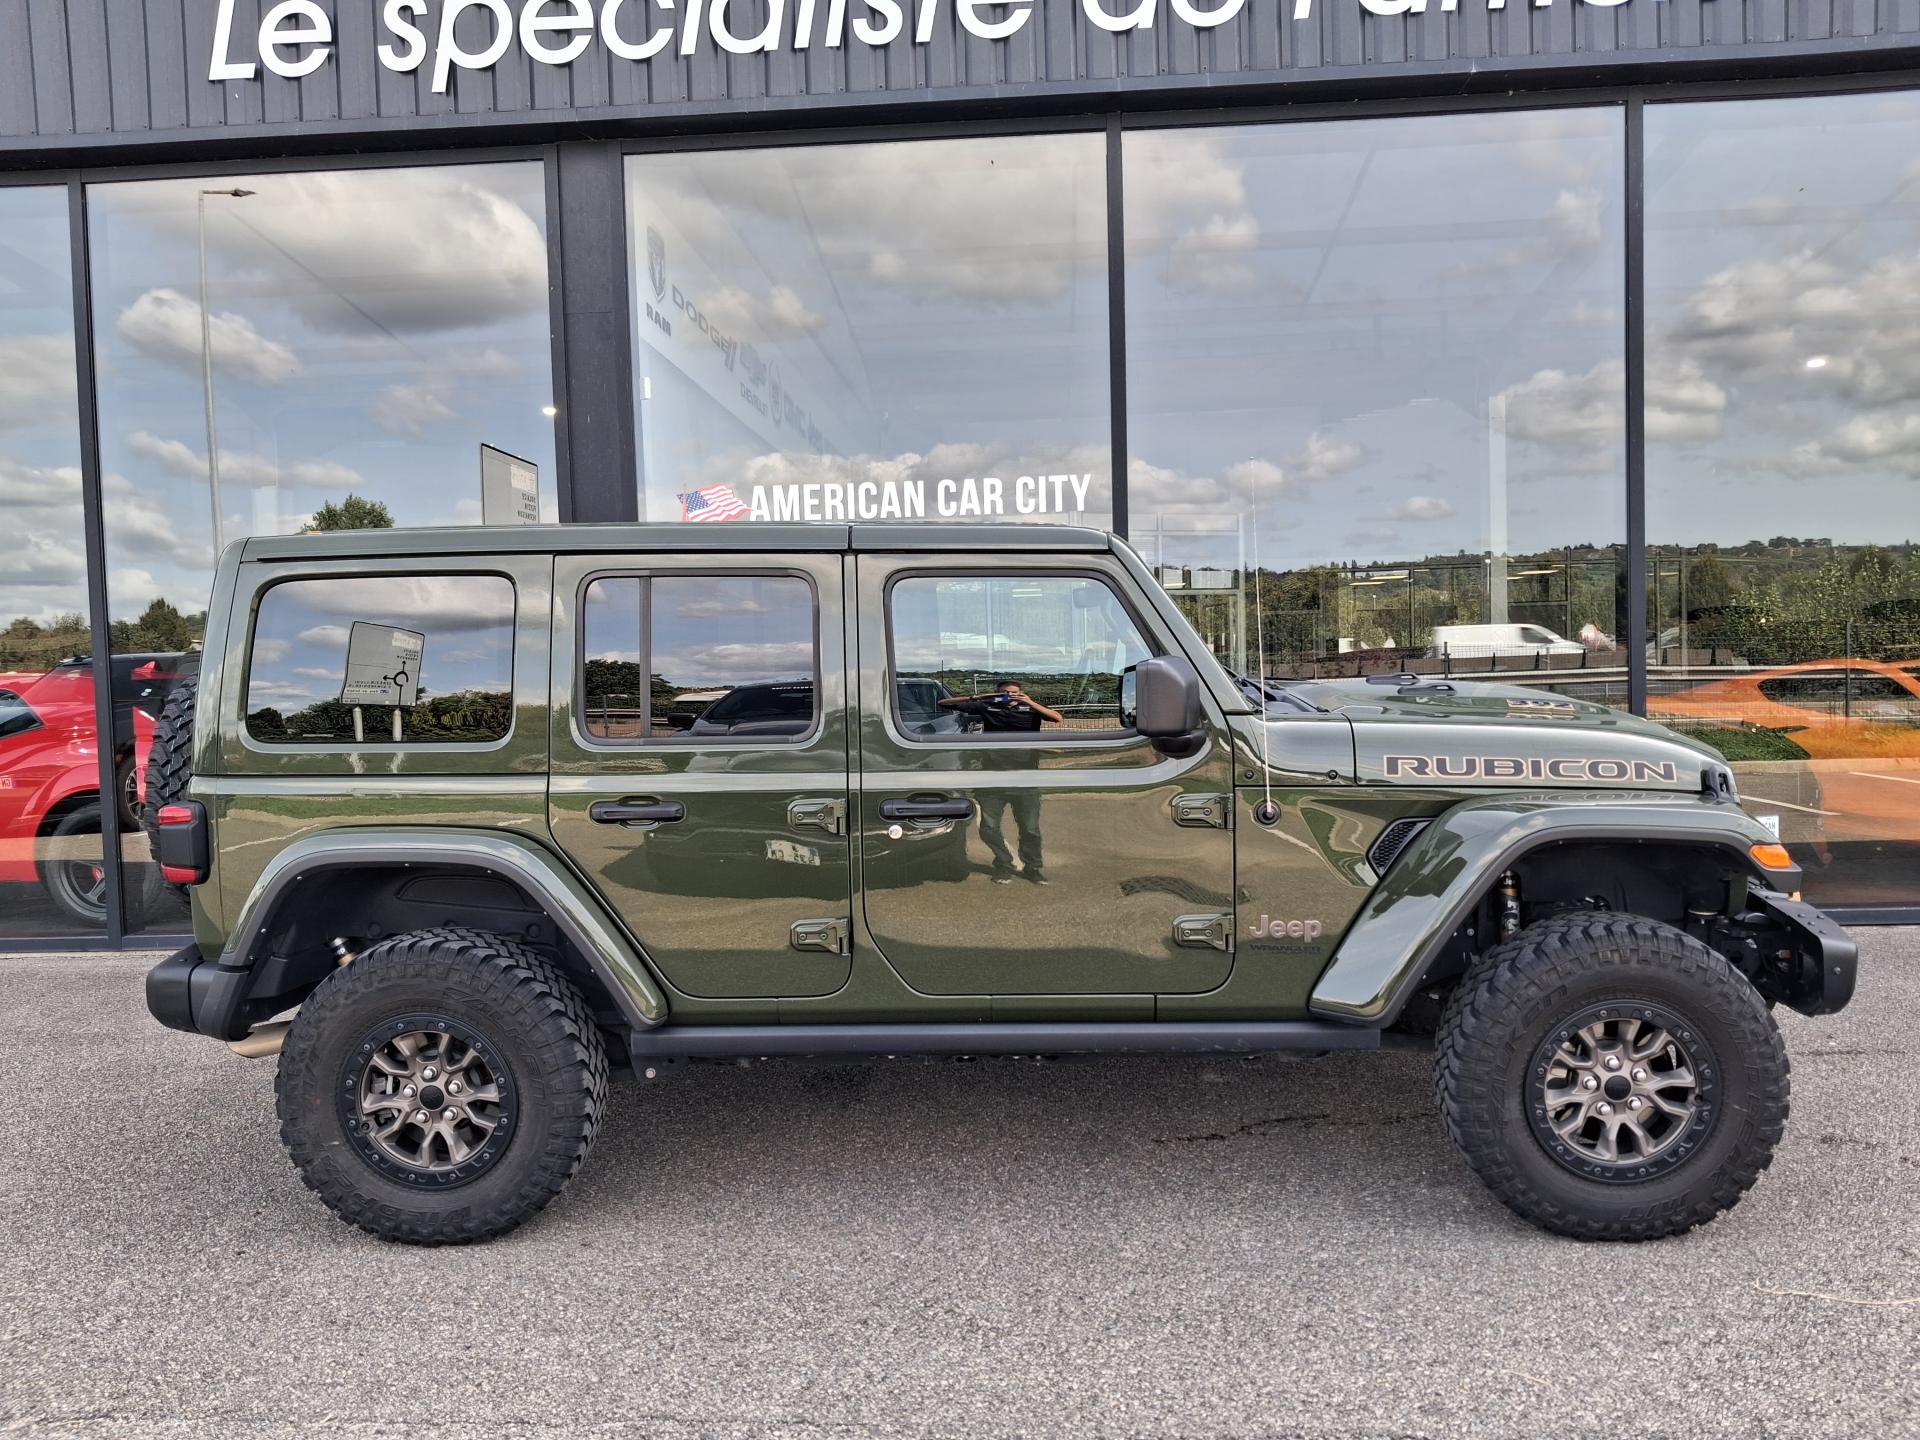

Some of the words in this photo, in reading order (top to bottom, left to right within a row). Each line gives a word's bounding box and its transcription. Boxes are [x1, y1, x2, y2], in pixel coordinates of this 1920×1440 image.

[208, 0, 332, 80] Le
[646, 302, 671, 337] RAM
[672, 284, 730, 354] DODGE
[750, 480, 924, 521] AMERICAN
[937, 478, 1003, 516] CAR
[1015, 474, 1091, 513] CITY
[1383, 755, 1677, 783] RUBICON
[1249, 914, 1322, 943] Jeep
